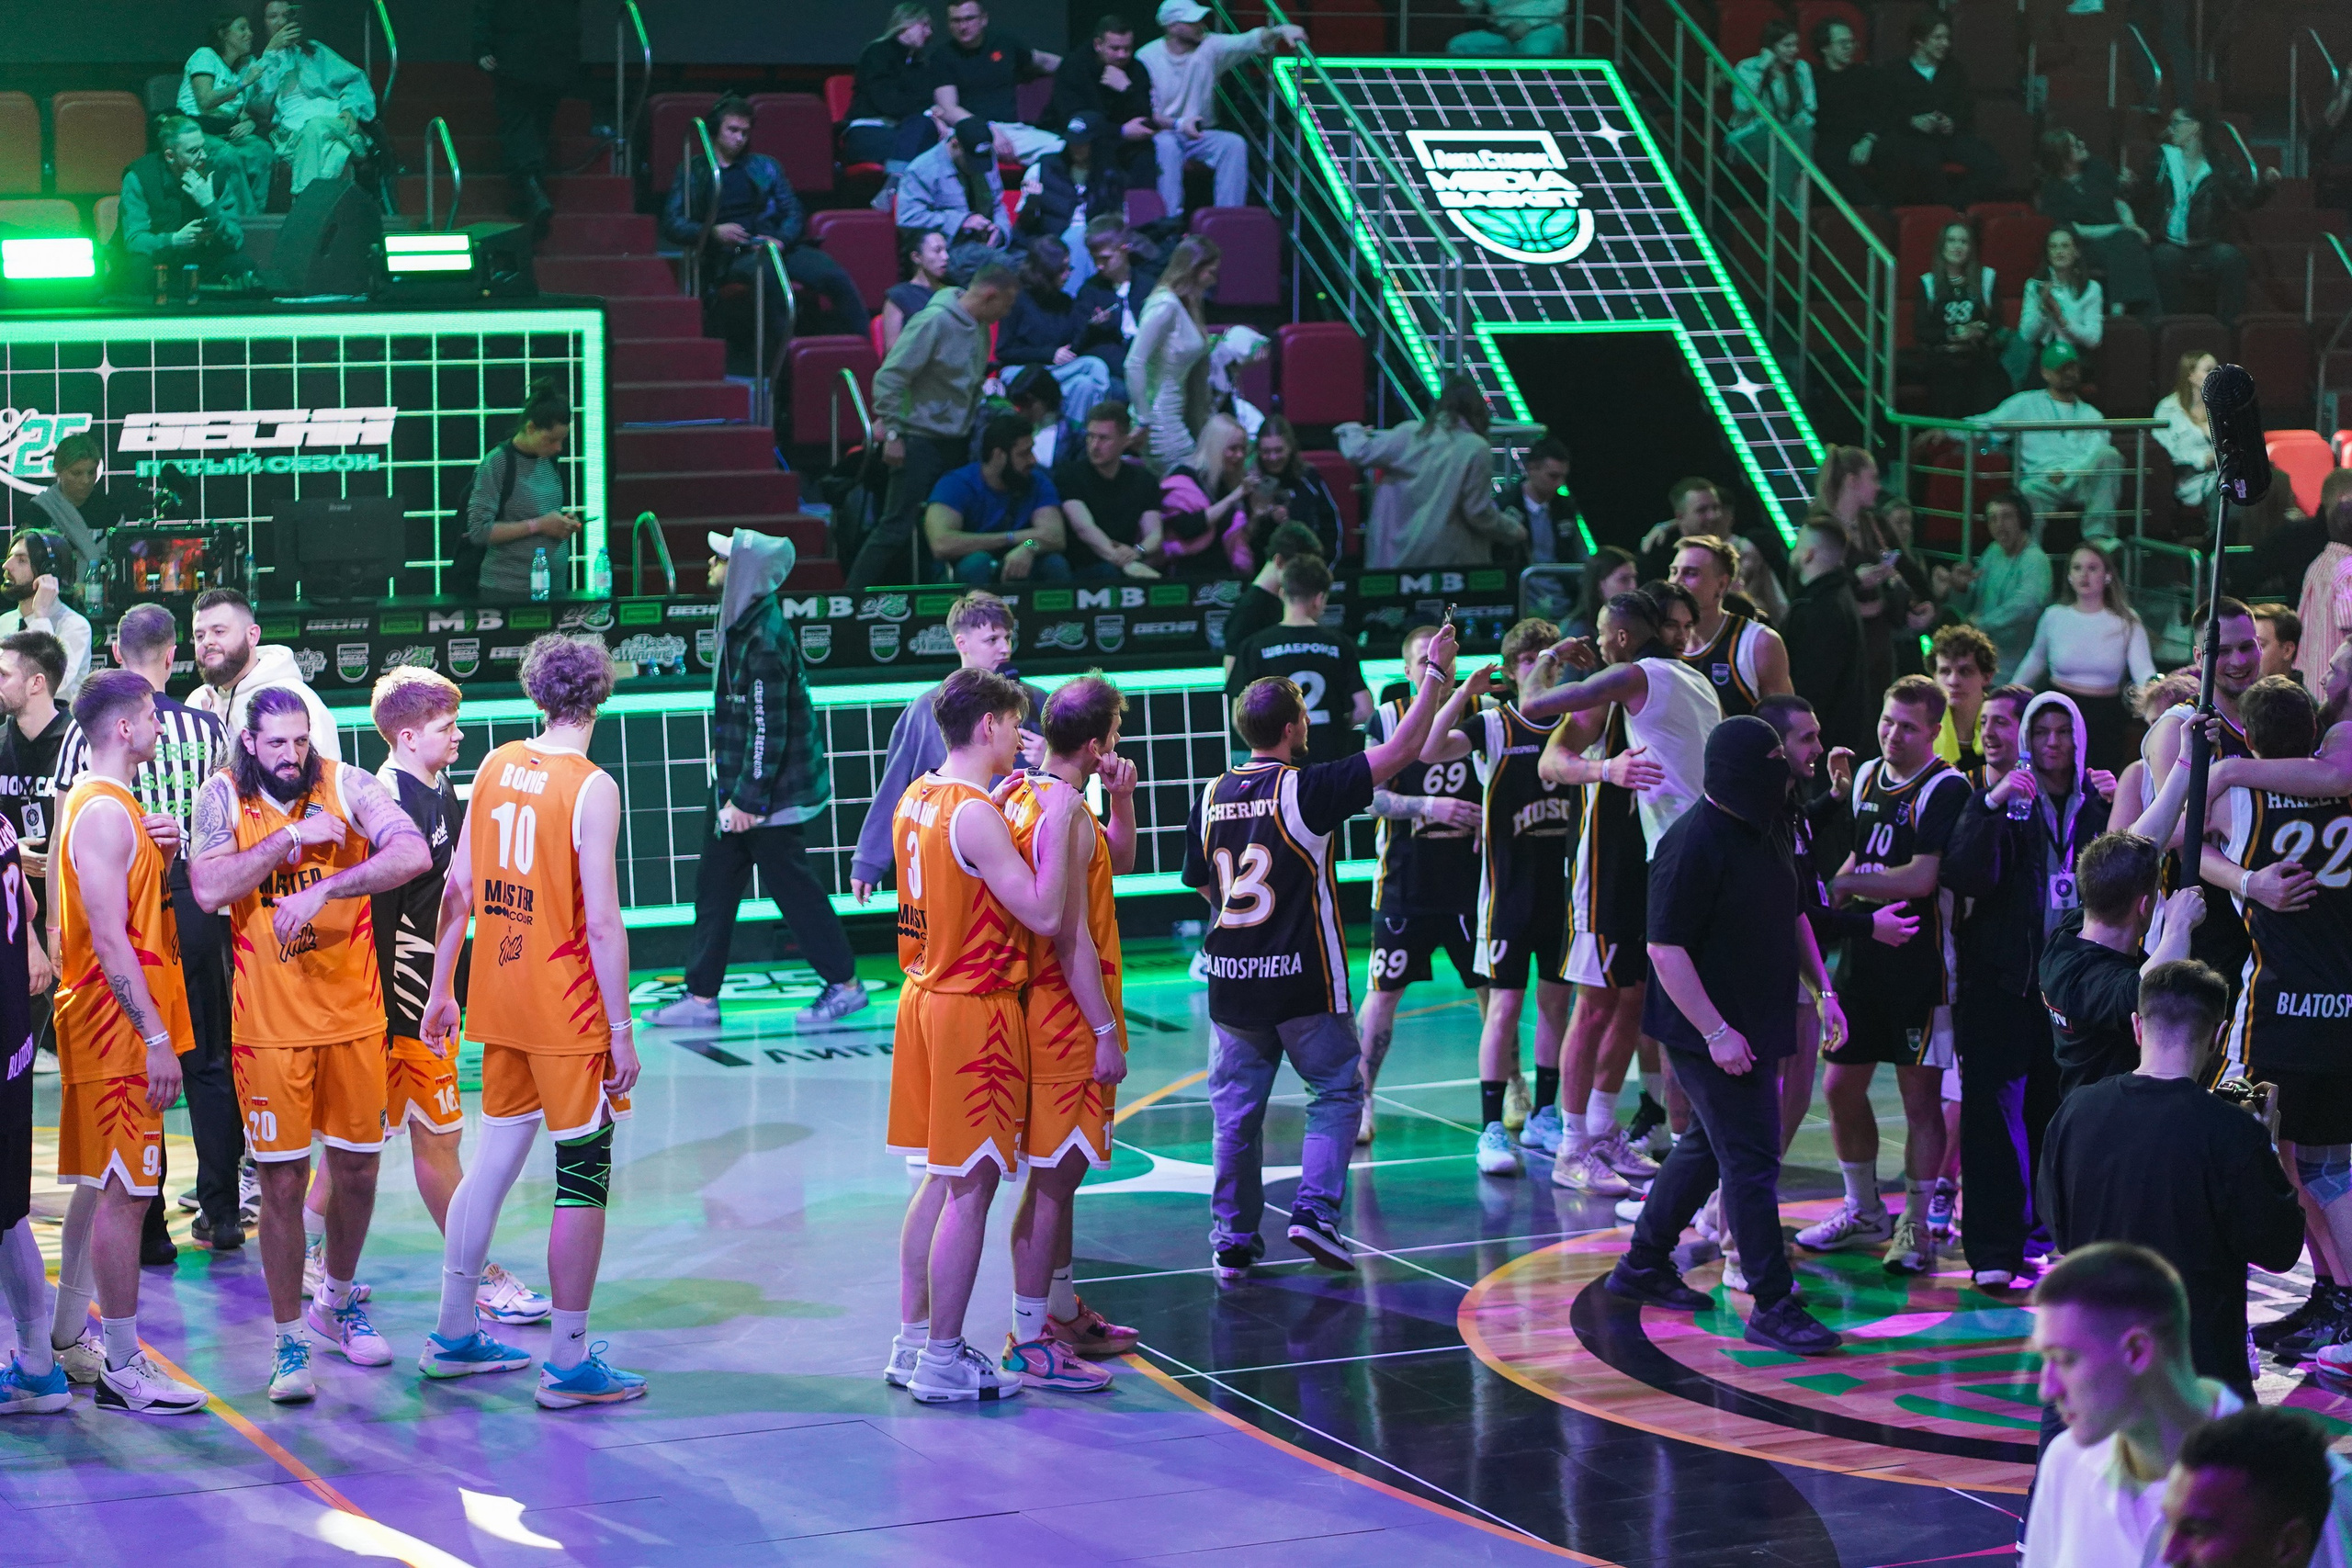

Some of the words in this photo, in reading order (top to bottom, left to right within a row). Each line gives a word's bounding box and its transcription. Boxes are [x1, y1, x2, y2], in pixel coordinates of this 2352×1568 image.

[262, 453, 379, 474] СЕЗОН
[1287, 670, 1330, 726] 2
[154, 741, 207, 761] EREE
[1422, 761, 1467, 795] 69
[1208, 797, 1280, 824] CHERNOV
[491, 801, 536, 875] 10
[1865, 821, 1894, 857] 10
[2271, 816, 2352, 888] 22
[906, 830, 922, 900] 3
[1212, 842, 1276, 930] 13
[1372, 947, 1408, 980] 69
[2276, 991, 2352, 1019] BLATOSP
[434, 1084, 459, 1115] 16
